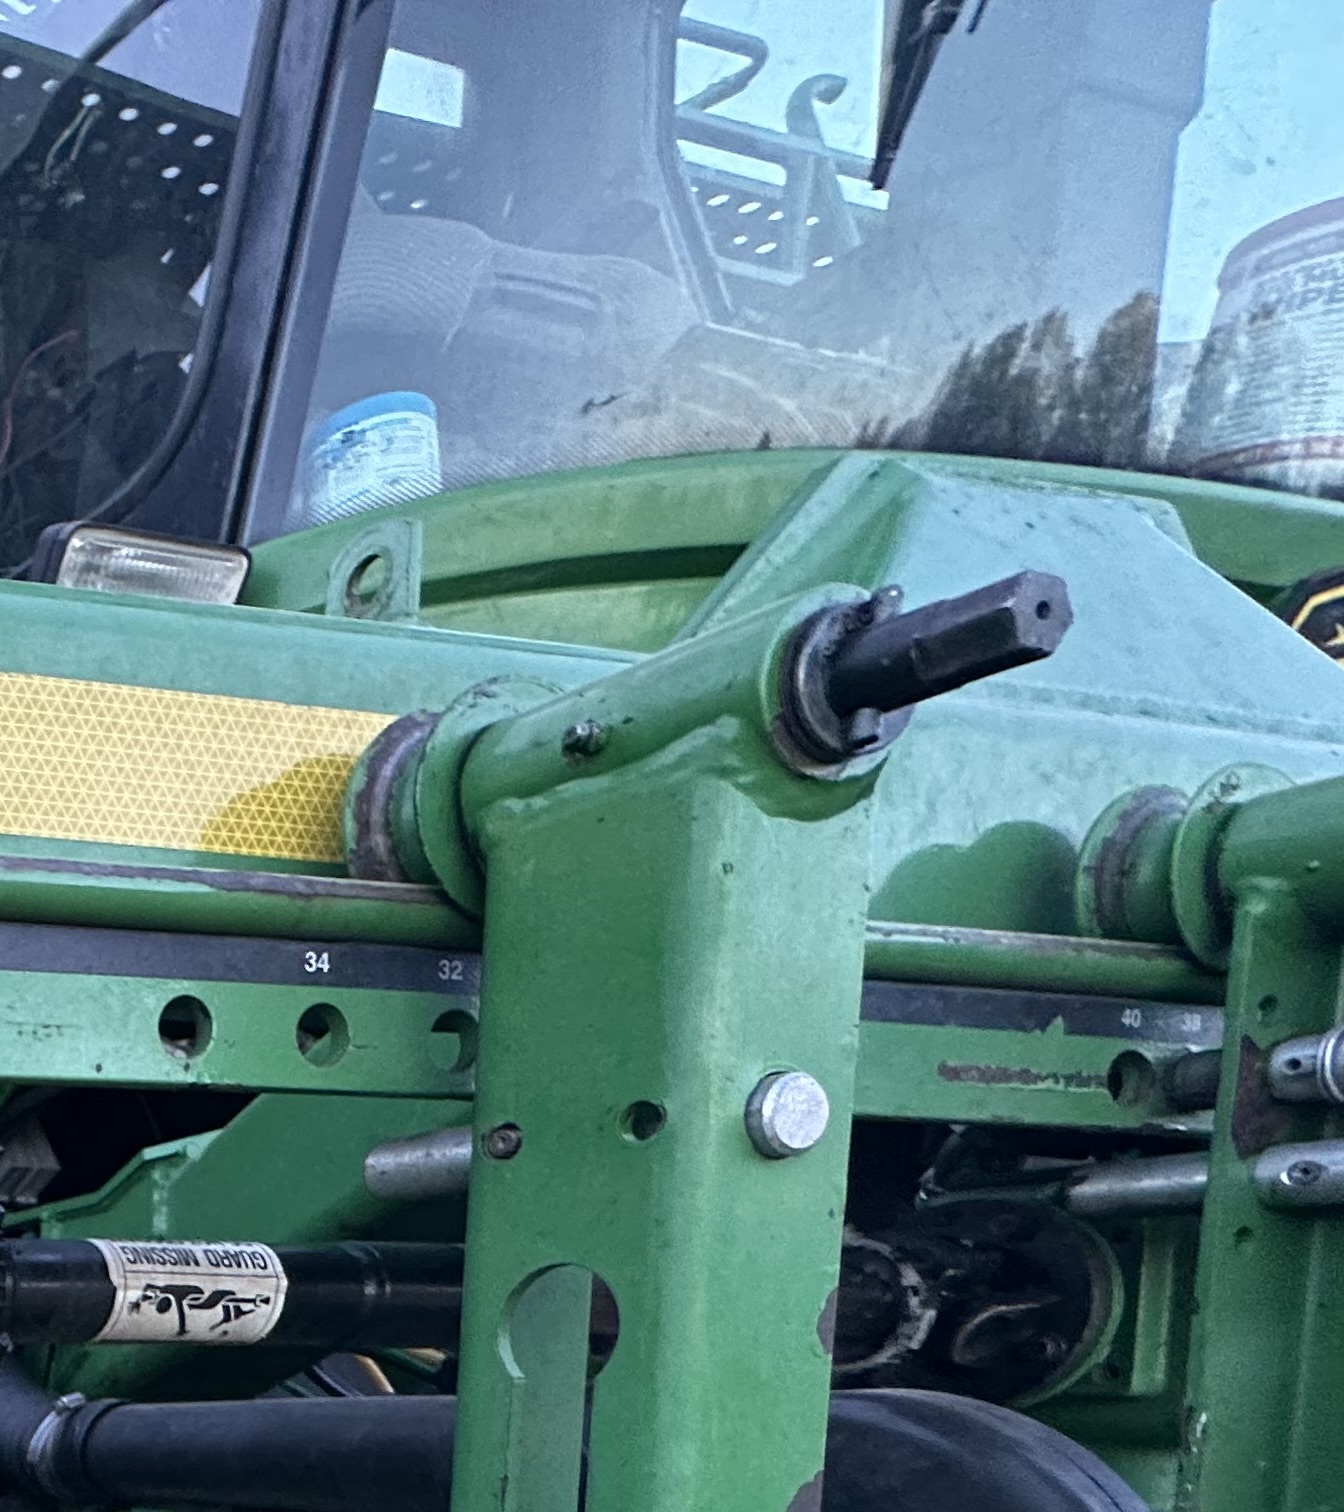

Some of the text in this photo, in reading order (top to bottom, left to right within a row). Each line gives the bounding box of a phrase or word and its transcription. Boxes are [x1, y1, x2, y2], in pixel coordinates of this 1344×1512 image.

[303, 951, 331, 973] 34
[437, 959, 464, 981] 32
[1120, 1007, 1142, 1029] 40
[120, 1245, 268, 1271] GUARD MISSING
